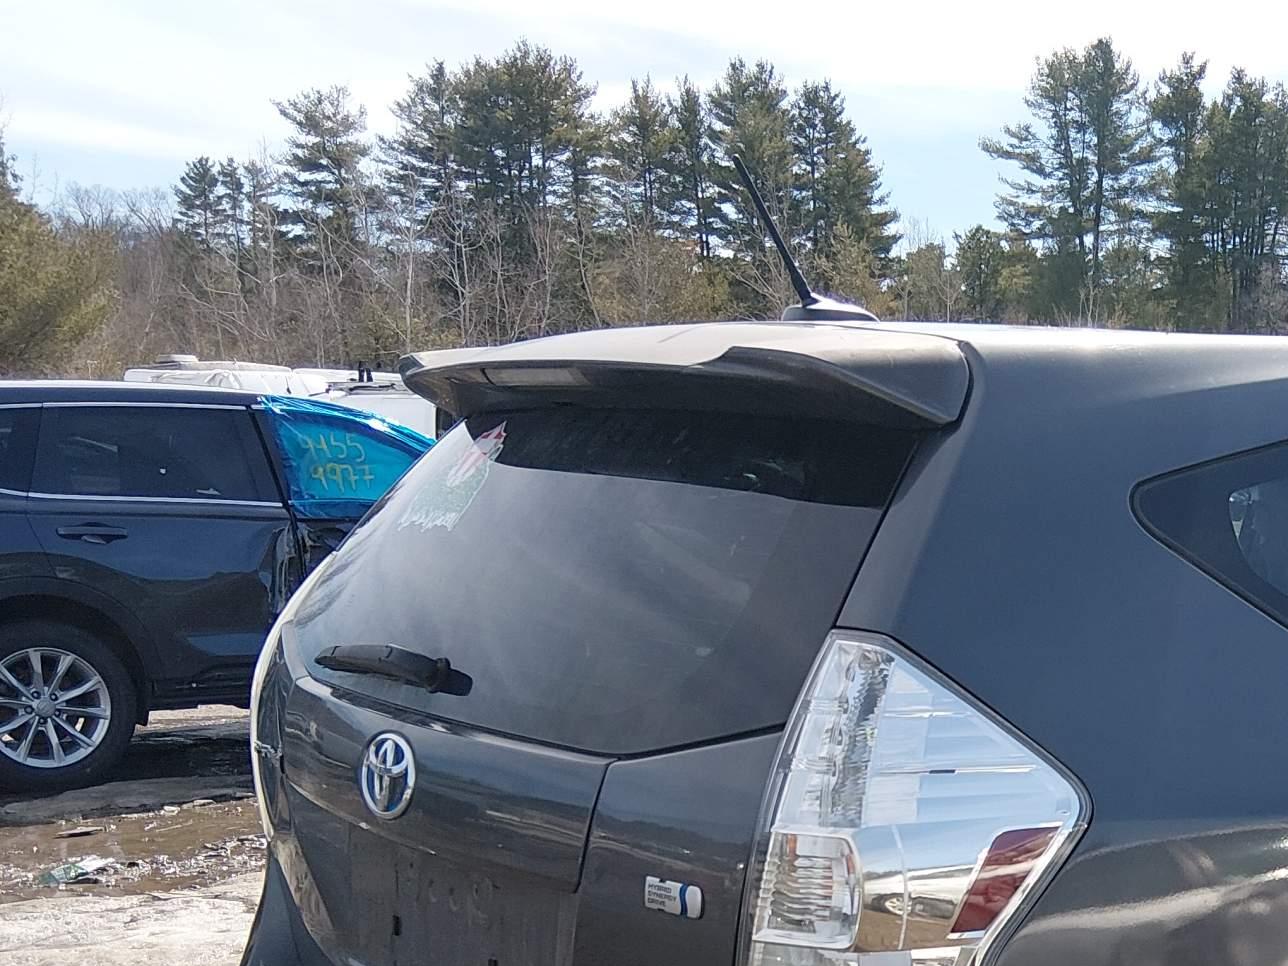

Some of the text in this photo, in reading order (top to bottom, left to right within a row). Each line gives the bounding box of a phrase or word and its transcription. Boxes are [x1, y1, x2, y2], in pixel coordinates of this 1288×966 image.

[647, 883, 672, 894] HYBRID
[647, 890, 677, 903] SYNERGY
[647, 897, 666, 908] DRIVE
